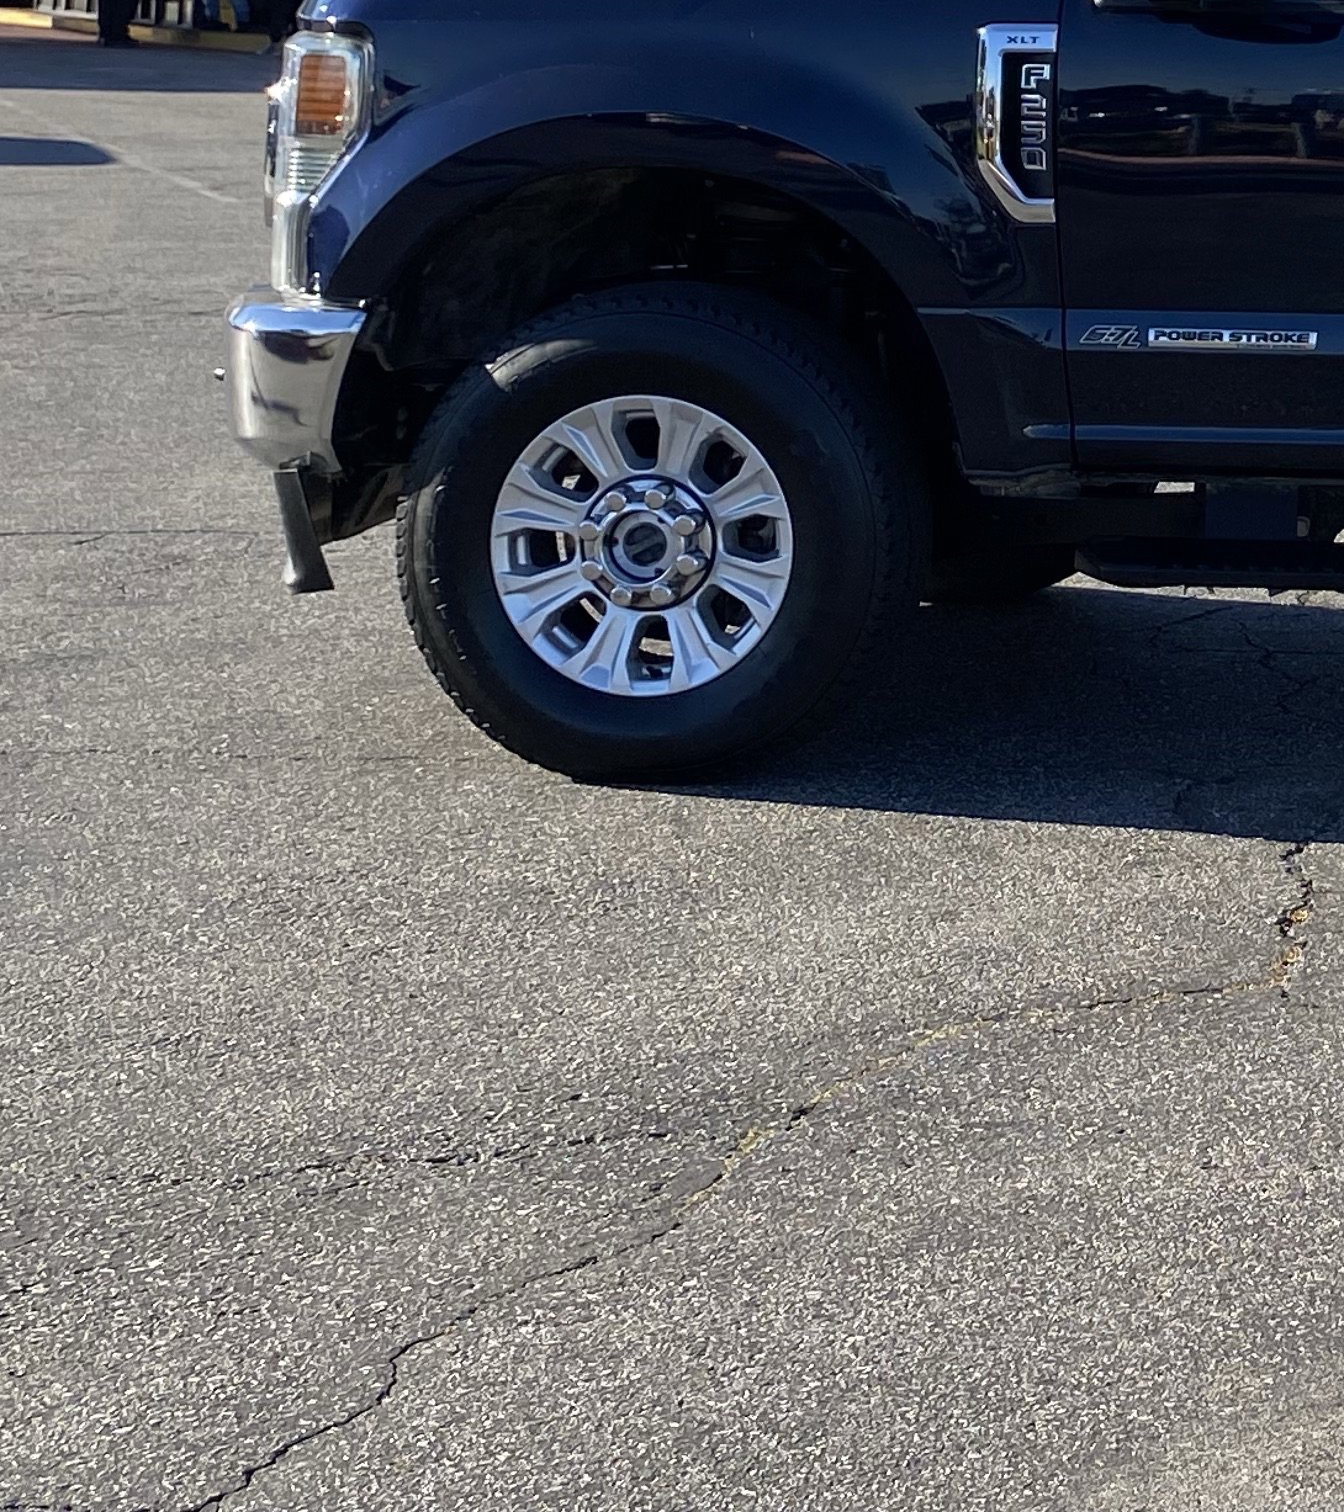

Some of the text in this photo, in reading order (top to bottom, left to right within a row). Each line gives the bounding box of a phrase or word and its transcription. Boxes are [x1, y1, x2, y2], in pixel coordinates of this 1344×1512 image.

[1006, 35, 1040, 44] XLT
[1153, 329, 1224, 341] POWER
[1228, 331, 1310, 344] STROKE
